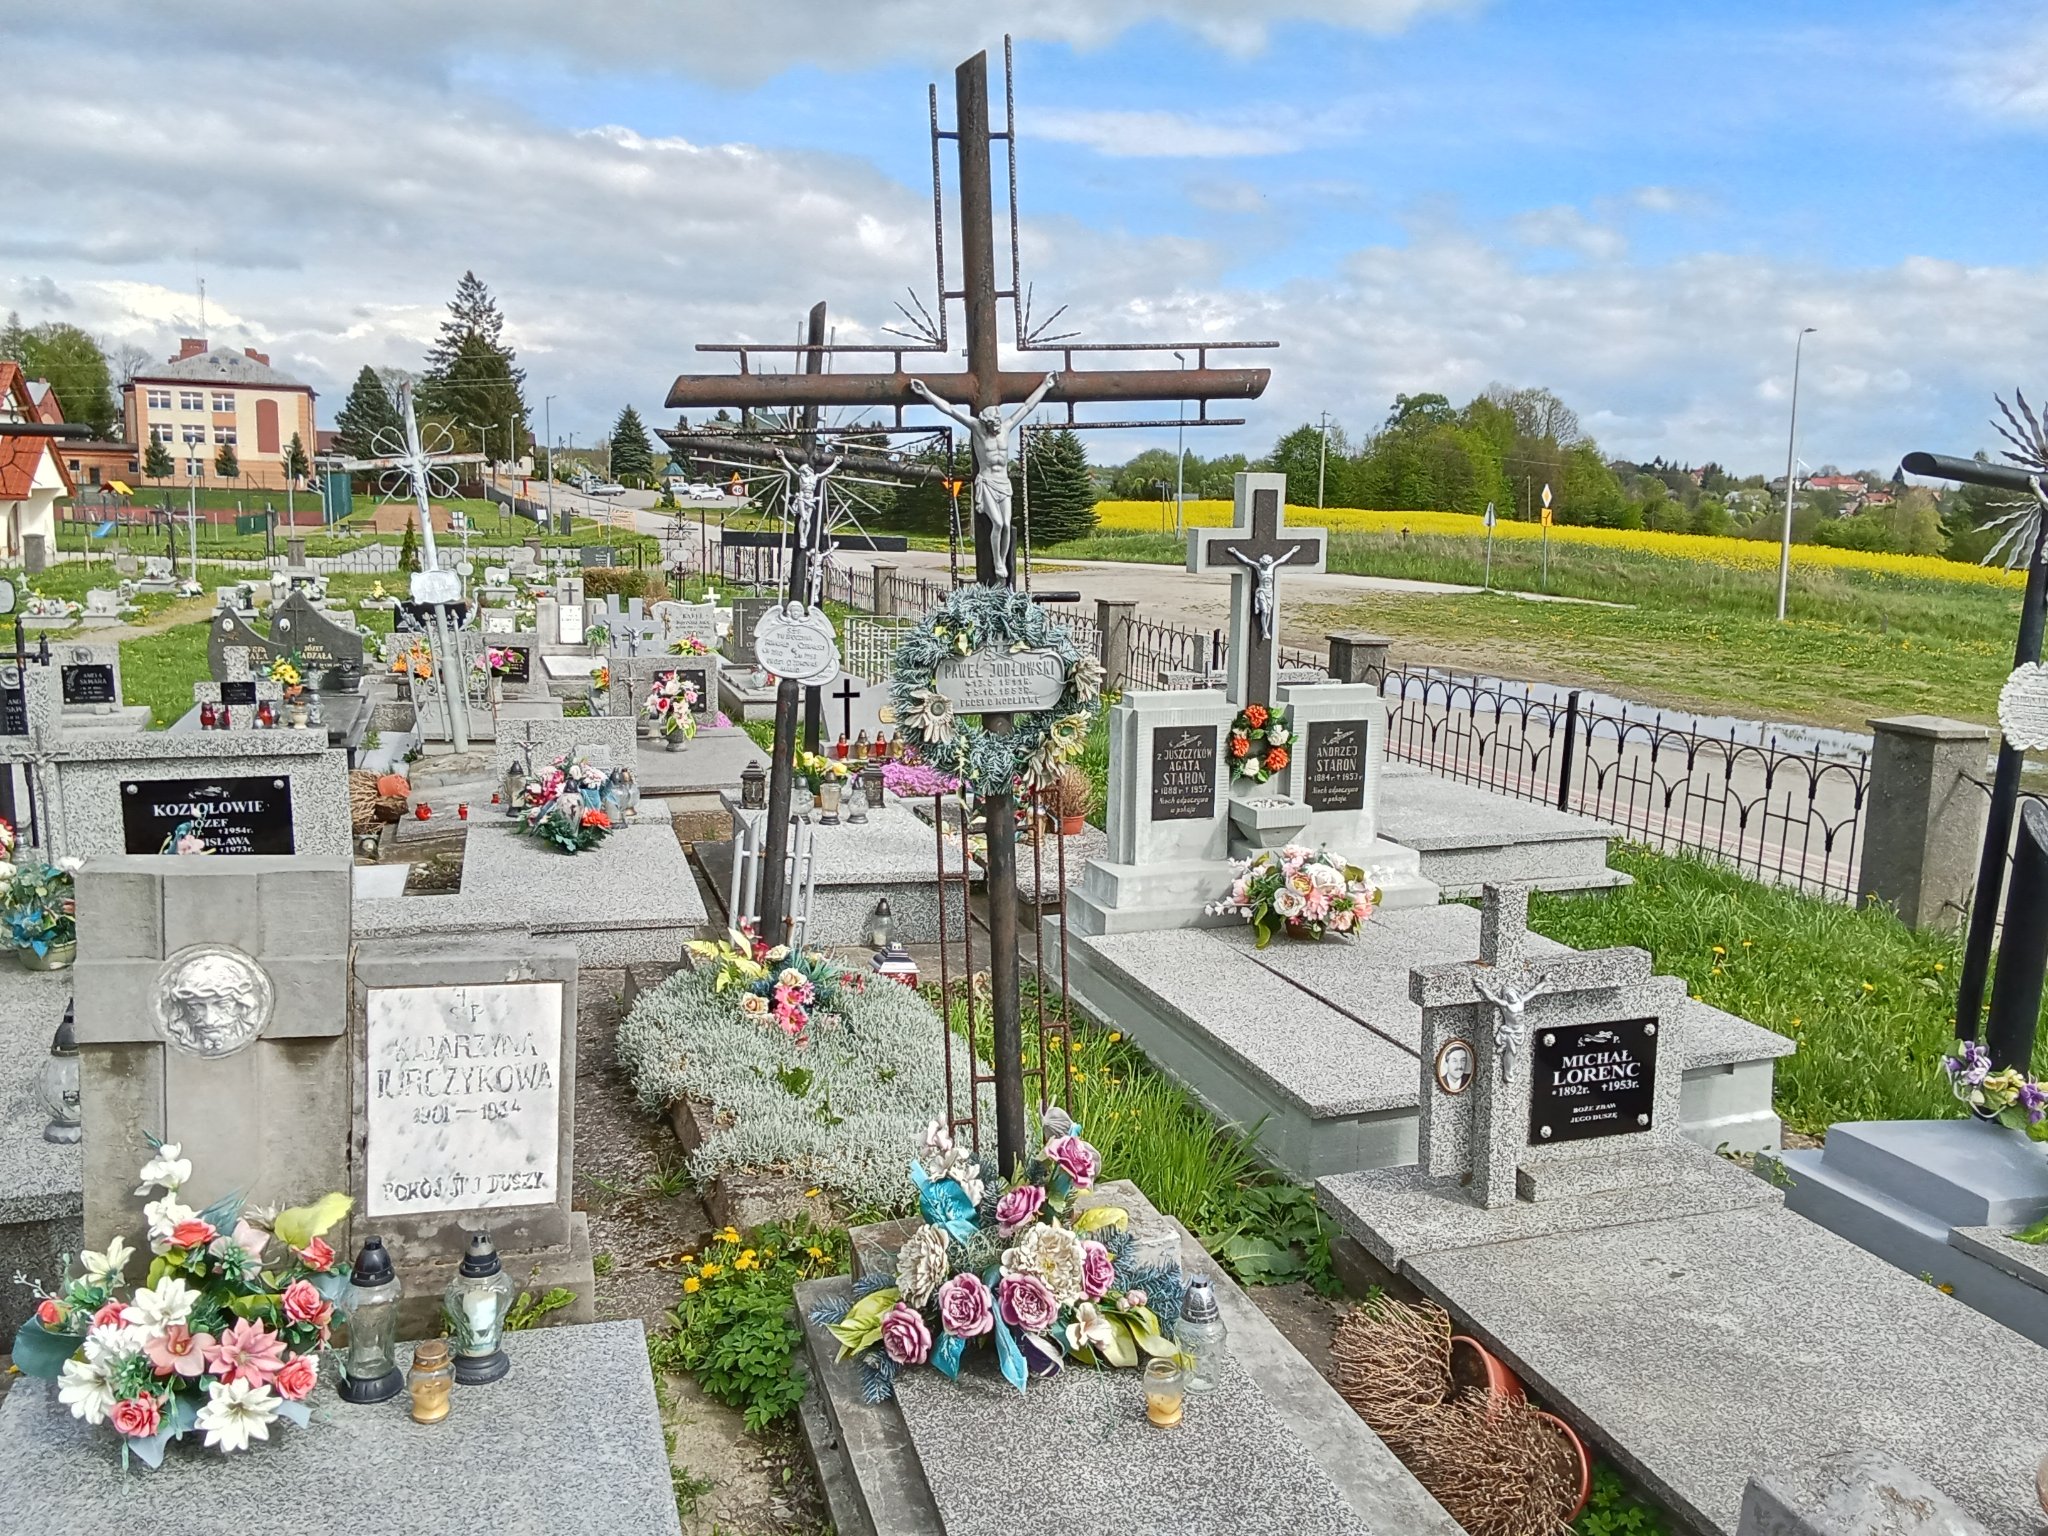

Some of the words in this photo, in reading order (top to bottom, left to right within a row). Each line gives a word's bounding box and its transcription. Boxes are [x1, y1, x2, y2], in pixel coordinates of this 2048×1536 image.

[944, 663, 983, 679] PAWEŁ
[1317, 745, 1358, 757] ANDRZEJ
[1169, 761, 1200, 771] AGATA
[153, 800, 265, 817] KOZIOŁOWIE
[1561, 1049, 1633, 1069] MICHAŁ
[1552, 1062, 1641, 1086] LORENC
[383, 1177, 442, 1201] POKÓJ
